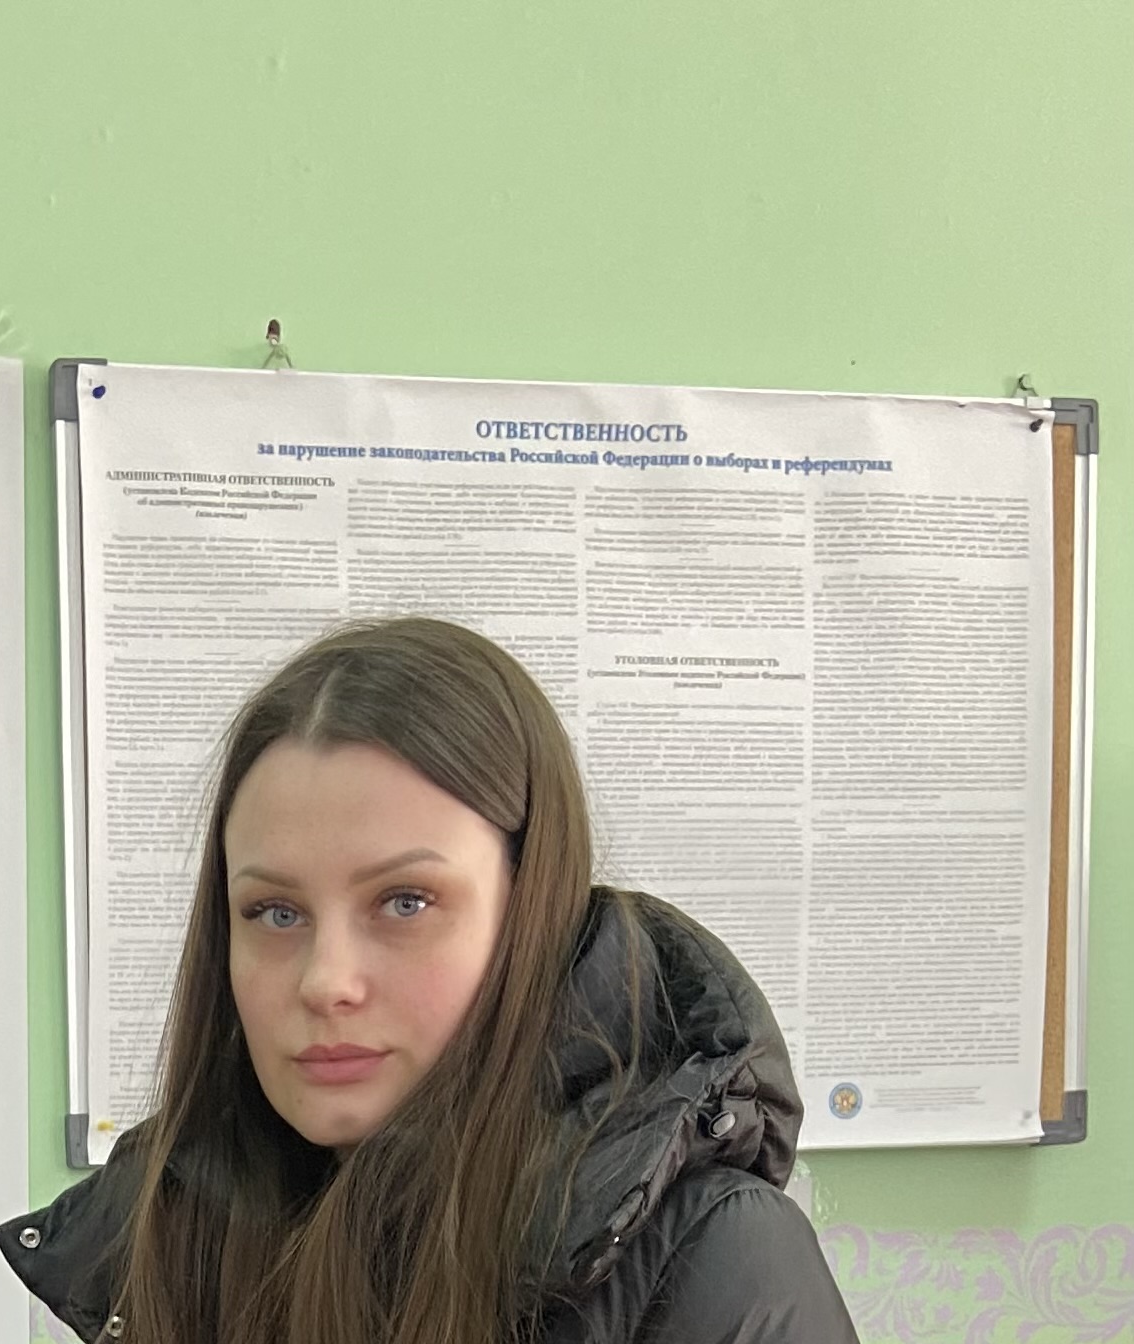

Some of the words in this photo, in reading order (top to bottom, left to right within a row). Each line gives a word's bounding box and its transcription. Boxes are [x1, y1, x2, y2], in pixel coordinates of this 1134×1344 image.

[476, 419, 688, 445] ОТВЕТСТВЕННОСТЬ
[257, 443, 274, 456] за
[278, 444, 365, 462] нарушение
[370, 446, 505, 466] законодательства
[510, 449, 596, 464] Российской
[602, 451, 690, 468] Федерации
[693, 457, 703, 466] о
[707, 453, 768, 472] выборах
[784, 455, 892, 475] референдумах
[228, 473, 336, 487] ОТВЕТСТВЕННОСТЬ
[680, 657, 780, 667] ОТВЕТСТВЕННОСТЬ
